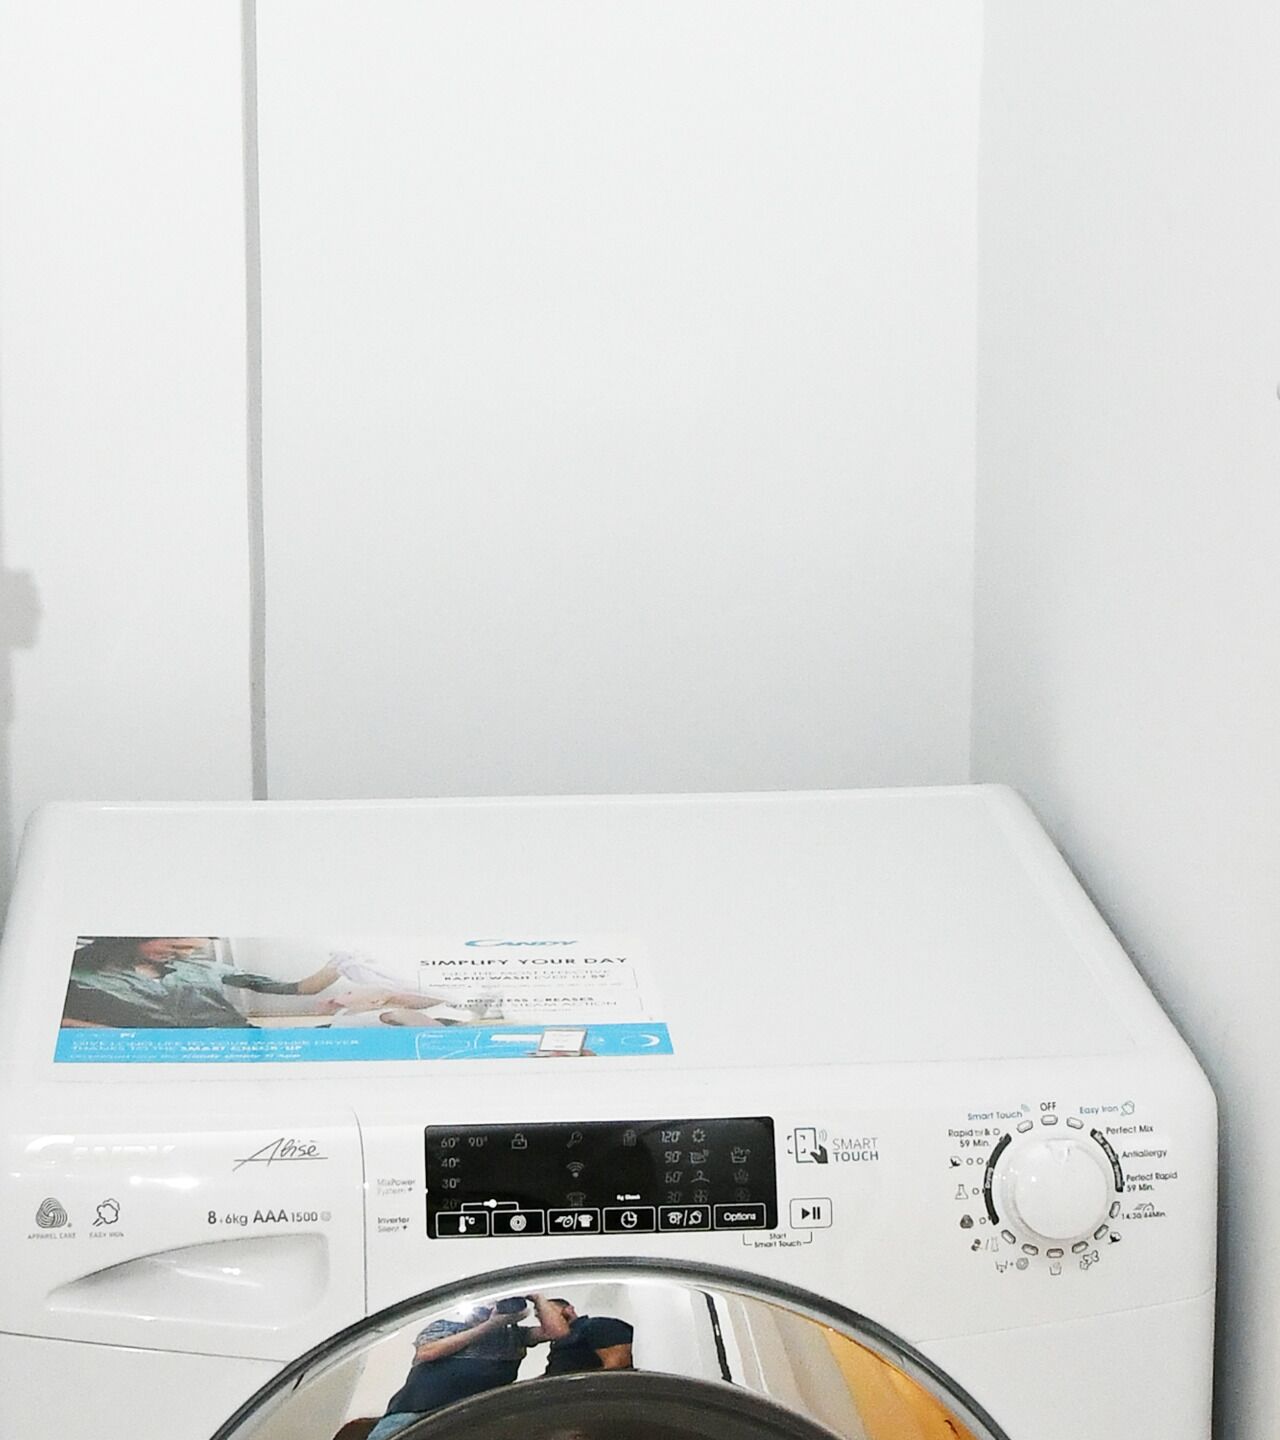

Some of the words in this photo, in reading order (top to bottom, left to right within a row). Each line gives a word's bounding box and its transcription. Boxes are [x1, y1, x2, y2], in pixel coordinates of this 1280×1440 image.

[420, 958, 509, 967] SIMPLIFY
[518, 957, 576, 966] YOUR
[583, 956, 628, 965] DAY
[1039, 1101, 1057, 1112] OFF
[1079, 1107, 1099, 1115] Easy
[967, 1112, 994, 1121] Smart
[996, 1111, 1023, 1120] Touch
[948, 1128, 973, 1138] Rapid
[1106, 1126, 1136, 1135] Perfect
[1139, 1125, 1154, 1133] Mix
[832, 1137, 878, 1151] SMART
[959, 1140, 970, 1148] 59
[833, 1151, 879, 1163] TOUCH
[1126, 1173, 1154, 1182] Perfect
[1155, 1172, 1178, 1181] Rapid
[1126, 1184, 1137, 1192] 59
[253, 1208, 289, 1223] AAA
[291, 1211, 318, 1222] 1500
[723, 1211, 757, 1223] Options
